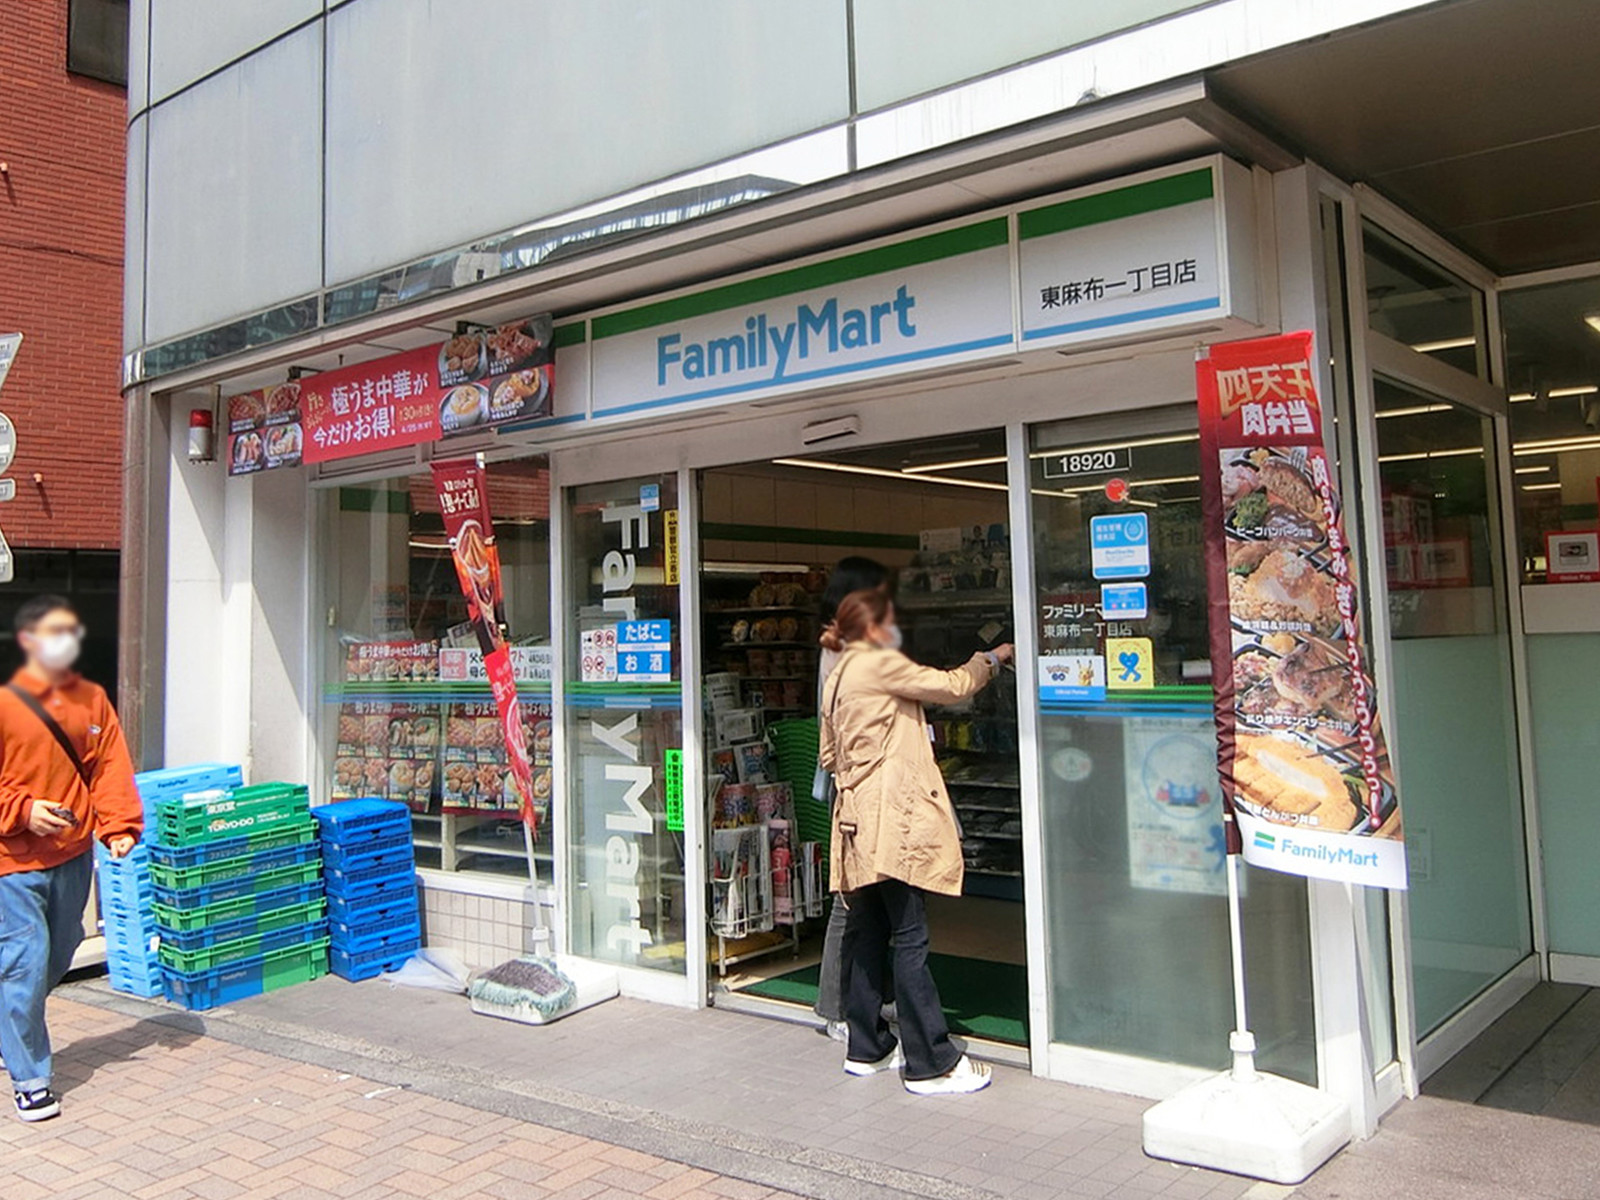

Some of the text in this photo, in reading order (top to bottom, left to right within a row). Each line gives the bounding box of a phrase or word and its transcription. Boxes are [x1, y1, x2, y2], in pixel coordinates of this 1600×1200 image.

[1040, 257, 1197, 310] 東麻布一丁目店
[656, 284, 917, 387] FamilyMart
[331, 370, 429, 416] 極うま中華が
[1216, 359, 1318, 419] 四天王
[313, 405, 396, 449] 今だけお得!
[1241, 399, 1315, 436] 肉弁当
[1060, 451, 1116, 474] 18920
[625, 623, 662, 641] たばこ
[625, 653, 638, 672] お
[1281, 839, 1379, 868] FamilyMart
